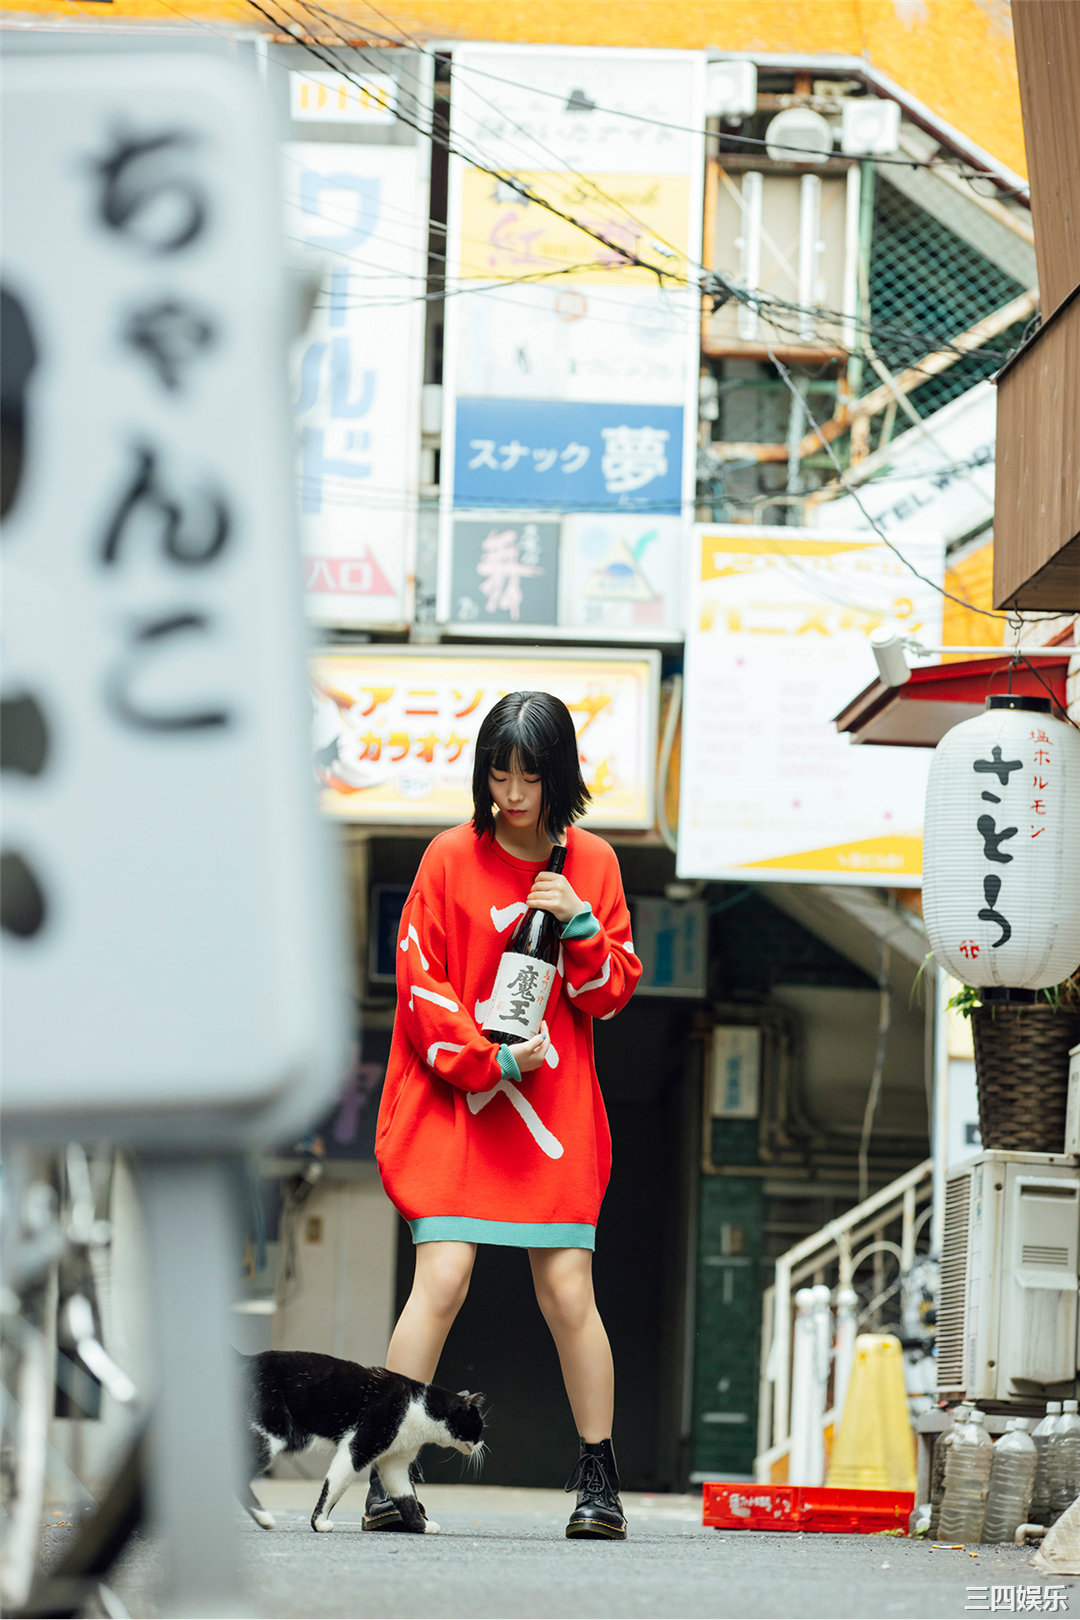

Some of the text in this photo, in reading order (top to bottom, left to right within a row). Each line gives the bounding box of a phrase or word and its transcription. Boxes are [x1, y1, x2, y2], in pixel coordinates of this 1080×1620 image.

[298, 173, 381, 515] ワールド
[90, 124, 232, 734] ちゃんこ
[468, 424, 669, 494] スナック 夢
[306, 560, 372, 591] 入口
[360, 685, 507, 718] アニソ
[359, 730, 469, 763] カラオケ
[1029, 728, 1053, 838] 塩ホルモン
[499, 965, 540, 1026] 魔王
